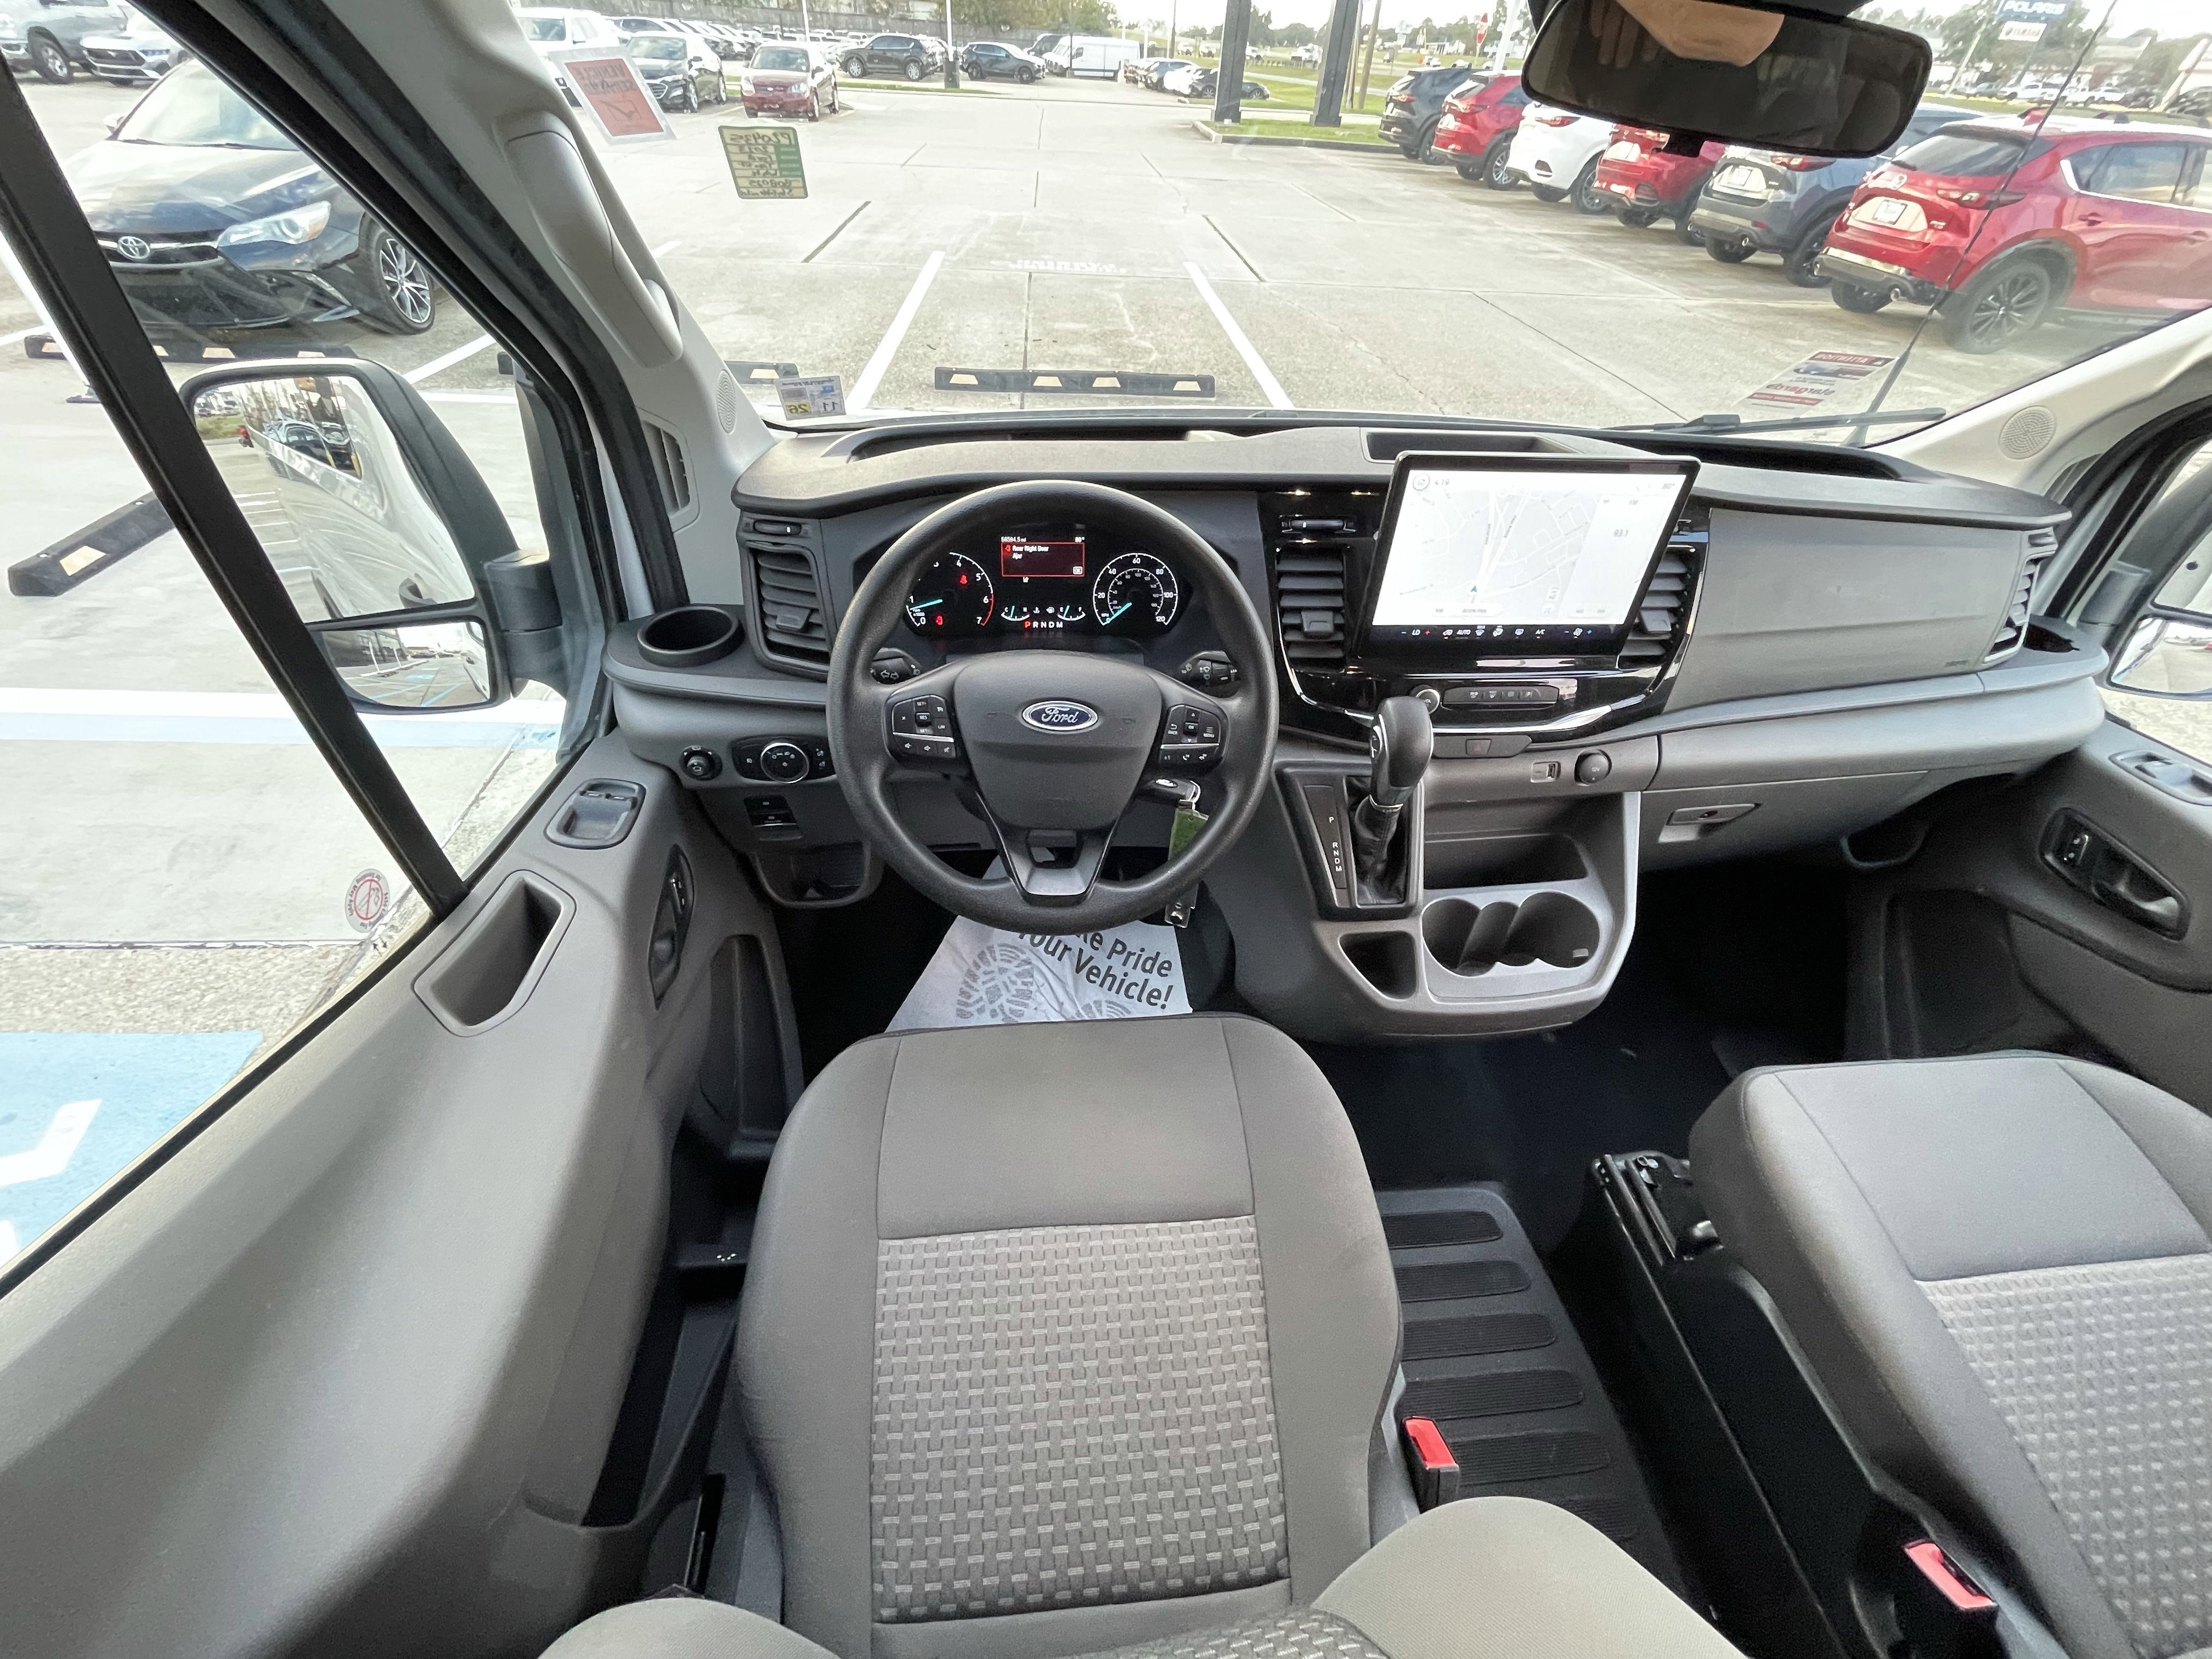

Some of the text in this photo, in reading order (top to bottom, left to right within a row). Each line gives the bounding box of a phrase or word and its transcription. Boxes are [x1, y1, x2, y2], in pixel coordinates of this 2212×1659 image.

[2002, 1, 2066, 14] POLARIS
[956, 559, 962, 567] 4
[975, 573, 981, 582] 5
[909, 595, 914, 603] 1
[983, 595, 989, 603] 6
[976, 616, 983, 624] 7
[1041, 706, 1080, 724] Ford
[1107, 938, 1172, 977] Pride
[1019, 933, 1072, 961] our
[1075, 947, 1173, 1009] Vehicle!
